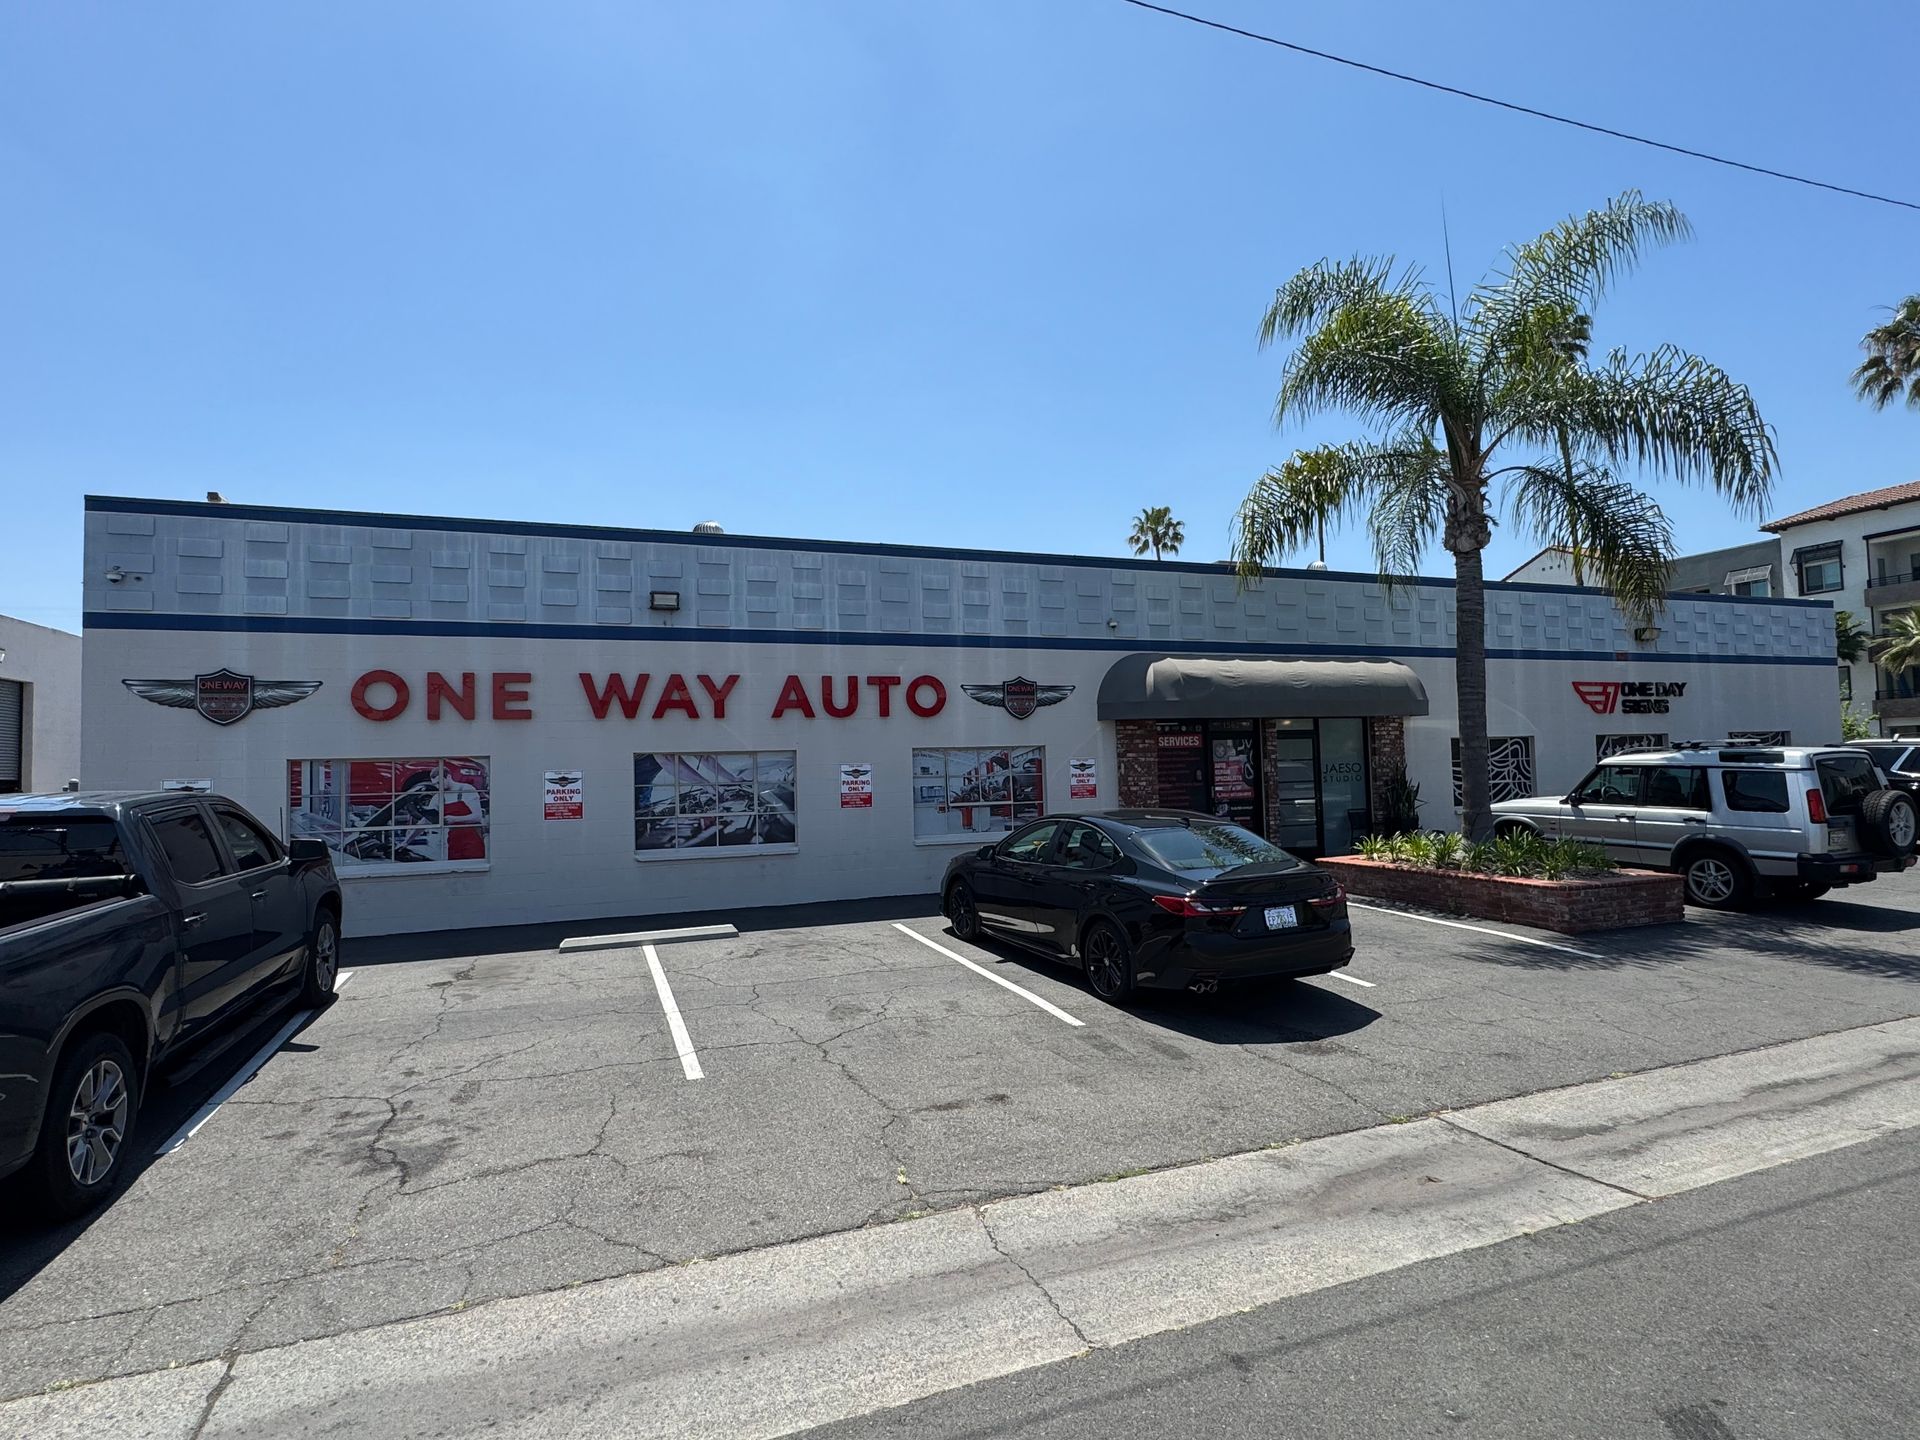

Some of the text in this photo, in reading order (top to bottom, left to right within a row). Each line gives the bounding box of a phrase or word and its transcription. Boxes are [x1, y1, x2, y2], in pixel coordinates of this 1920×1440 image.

[351, 669, 946, 722] ONE WAY AUTO
[1620, 682, 1687, 697] ONE DAY
[1158, 735, 1200, 747] SERVICES
[1323, 762, 1362, 774] JAESO
[1323, 774, 1362, 783] STUDIO
